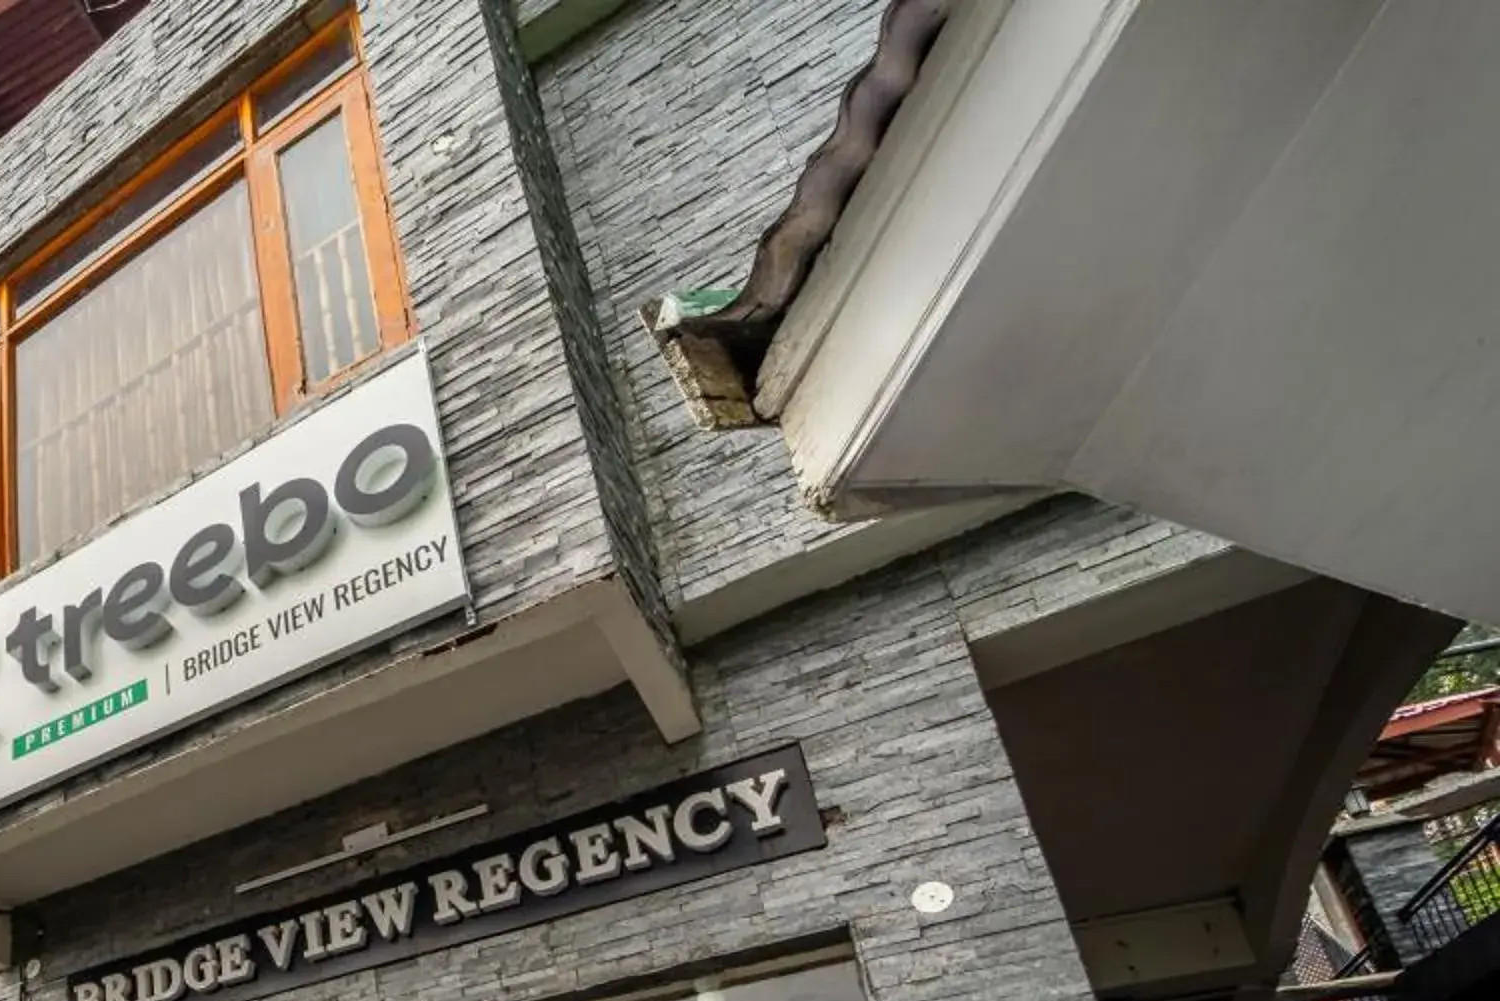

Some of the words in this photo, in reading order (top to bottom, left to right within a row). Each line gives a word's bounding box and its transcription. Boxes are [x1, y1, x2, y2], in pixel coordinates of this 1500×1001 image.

[5, 422, 440, 694] treebo
[182, 624, 262, 682] BRIDGE
[267, 592, 325, 640] VIEW
[333, 535, 448, 610] REGENCY
[25, 687, 134, 750] PREMIUM
[257, 881, 420, 971] VIEW
[428, 768, 792, 924] REGENCY
